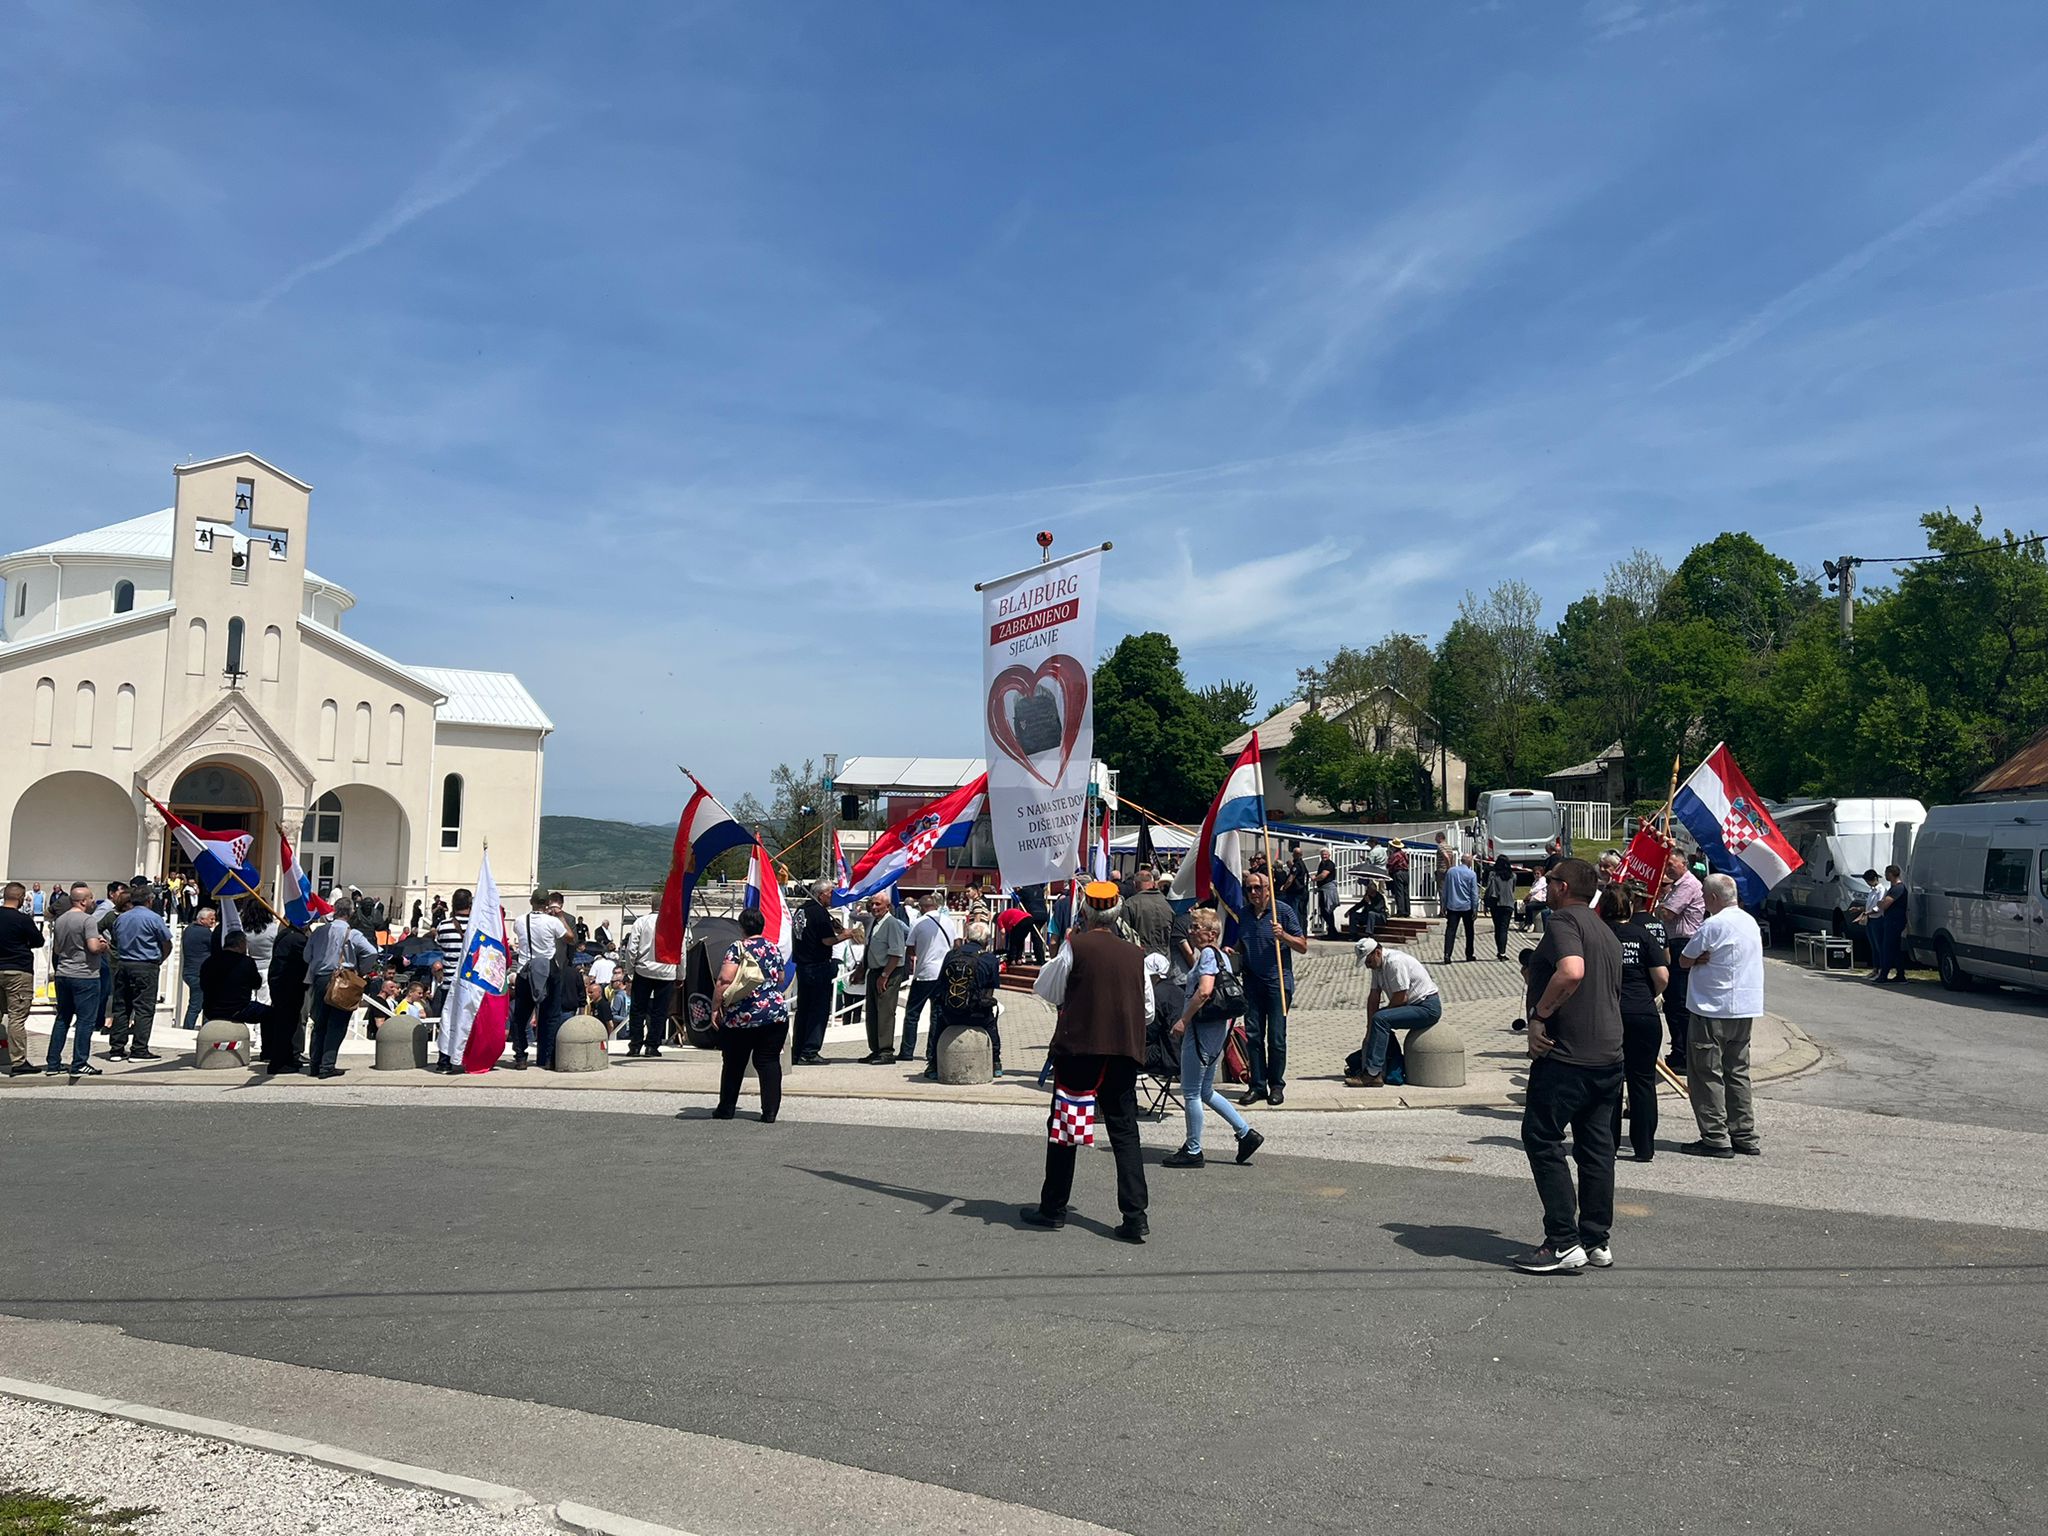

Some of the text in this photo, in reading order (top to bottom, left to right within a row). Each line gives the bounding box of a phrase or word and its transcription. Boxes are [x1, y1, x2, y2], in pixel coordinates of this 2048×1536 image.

[998, 574, 1078, 617] BLAJBURG
[998, 604, 1070, 639] ZABRANJENO
[1009, 629, 1059, 657] SJEĆANJE
[1017, 807, 1024, 818] S
[1029, 817, 1052, 833] DIŠE
[1055, 812, 1080, 828] ZADN
